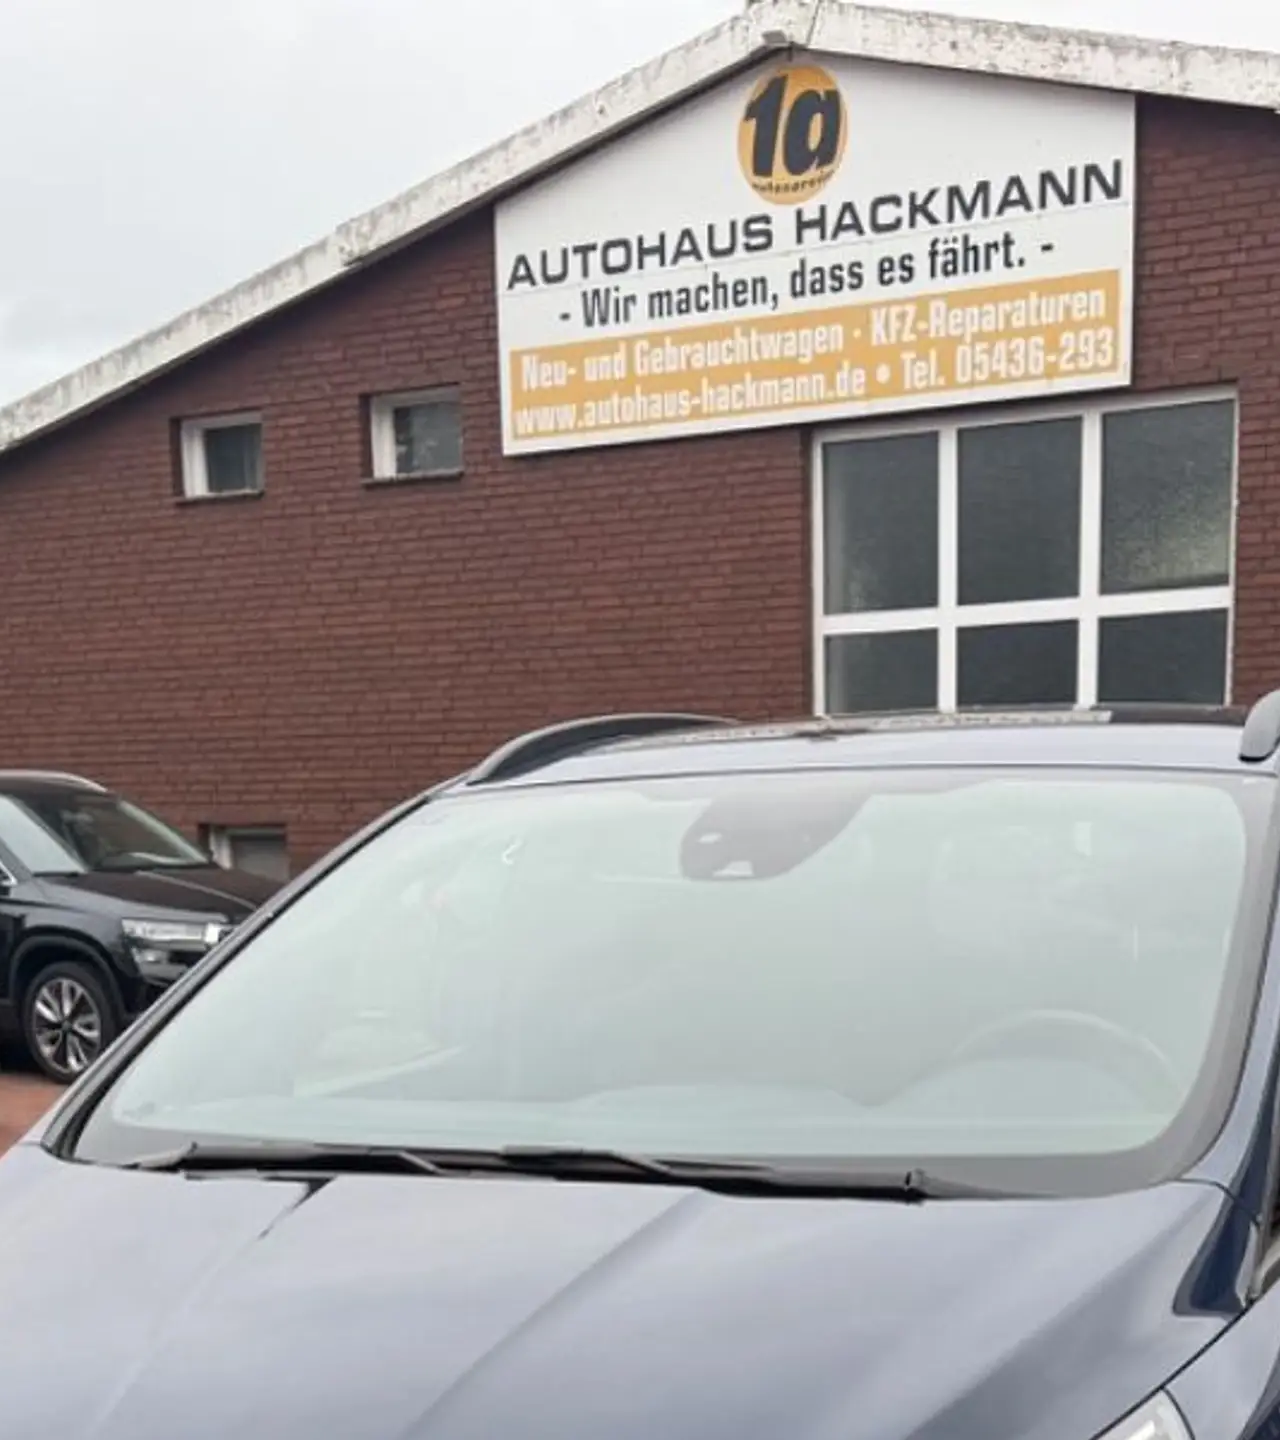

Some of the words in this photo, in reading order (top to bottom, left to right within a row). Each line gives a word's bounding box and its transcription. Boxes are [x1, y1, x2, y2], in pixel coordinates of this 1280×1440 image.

[744, 73, 841, 177] 1a
[507, 213, 774, 291] AUTOHAUS
[795, 158, 1123, 245] HACKMANN
[581, 285, 637, 328] Wir
[647, 271, 779, 320] machen,
[789, 257, 865, 299] dass
[877, 252, 915, 287] es
[928, 231, 1026, 280] fährt.
[512, 359, 866, 435] www.autohaus-hackmann.de
[900, 348, 946, 389] Tel.
[955, 325, 1115, 383] 05436-293
[521, 354, 578, 393] Neu-
[583, 340, 627, 384] und
[633, 322, 844, 378] Gebrauchtwagen
[870, 288, 1107, 347] KFZ-Reparaturen
